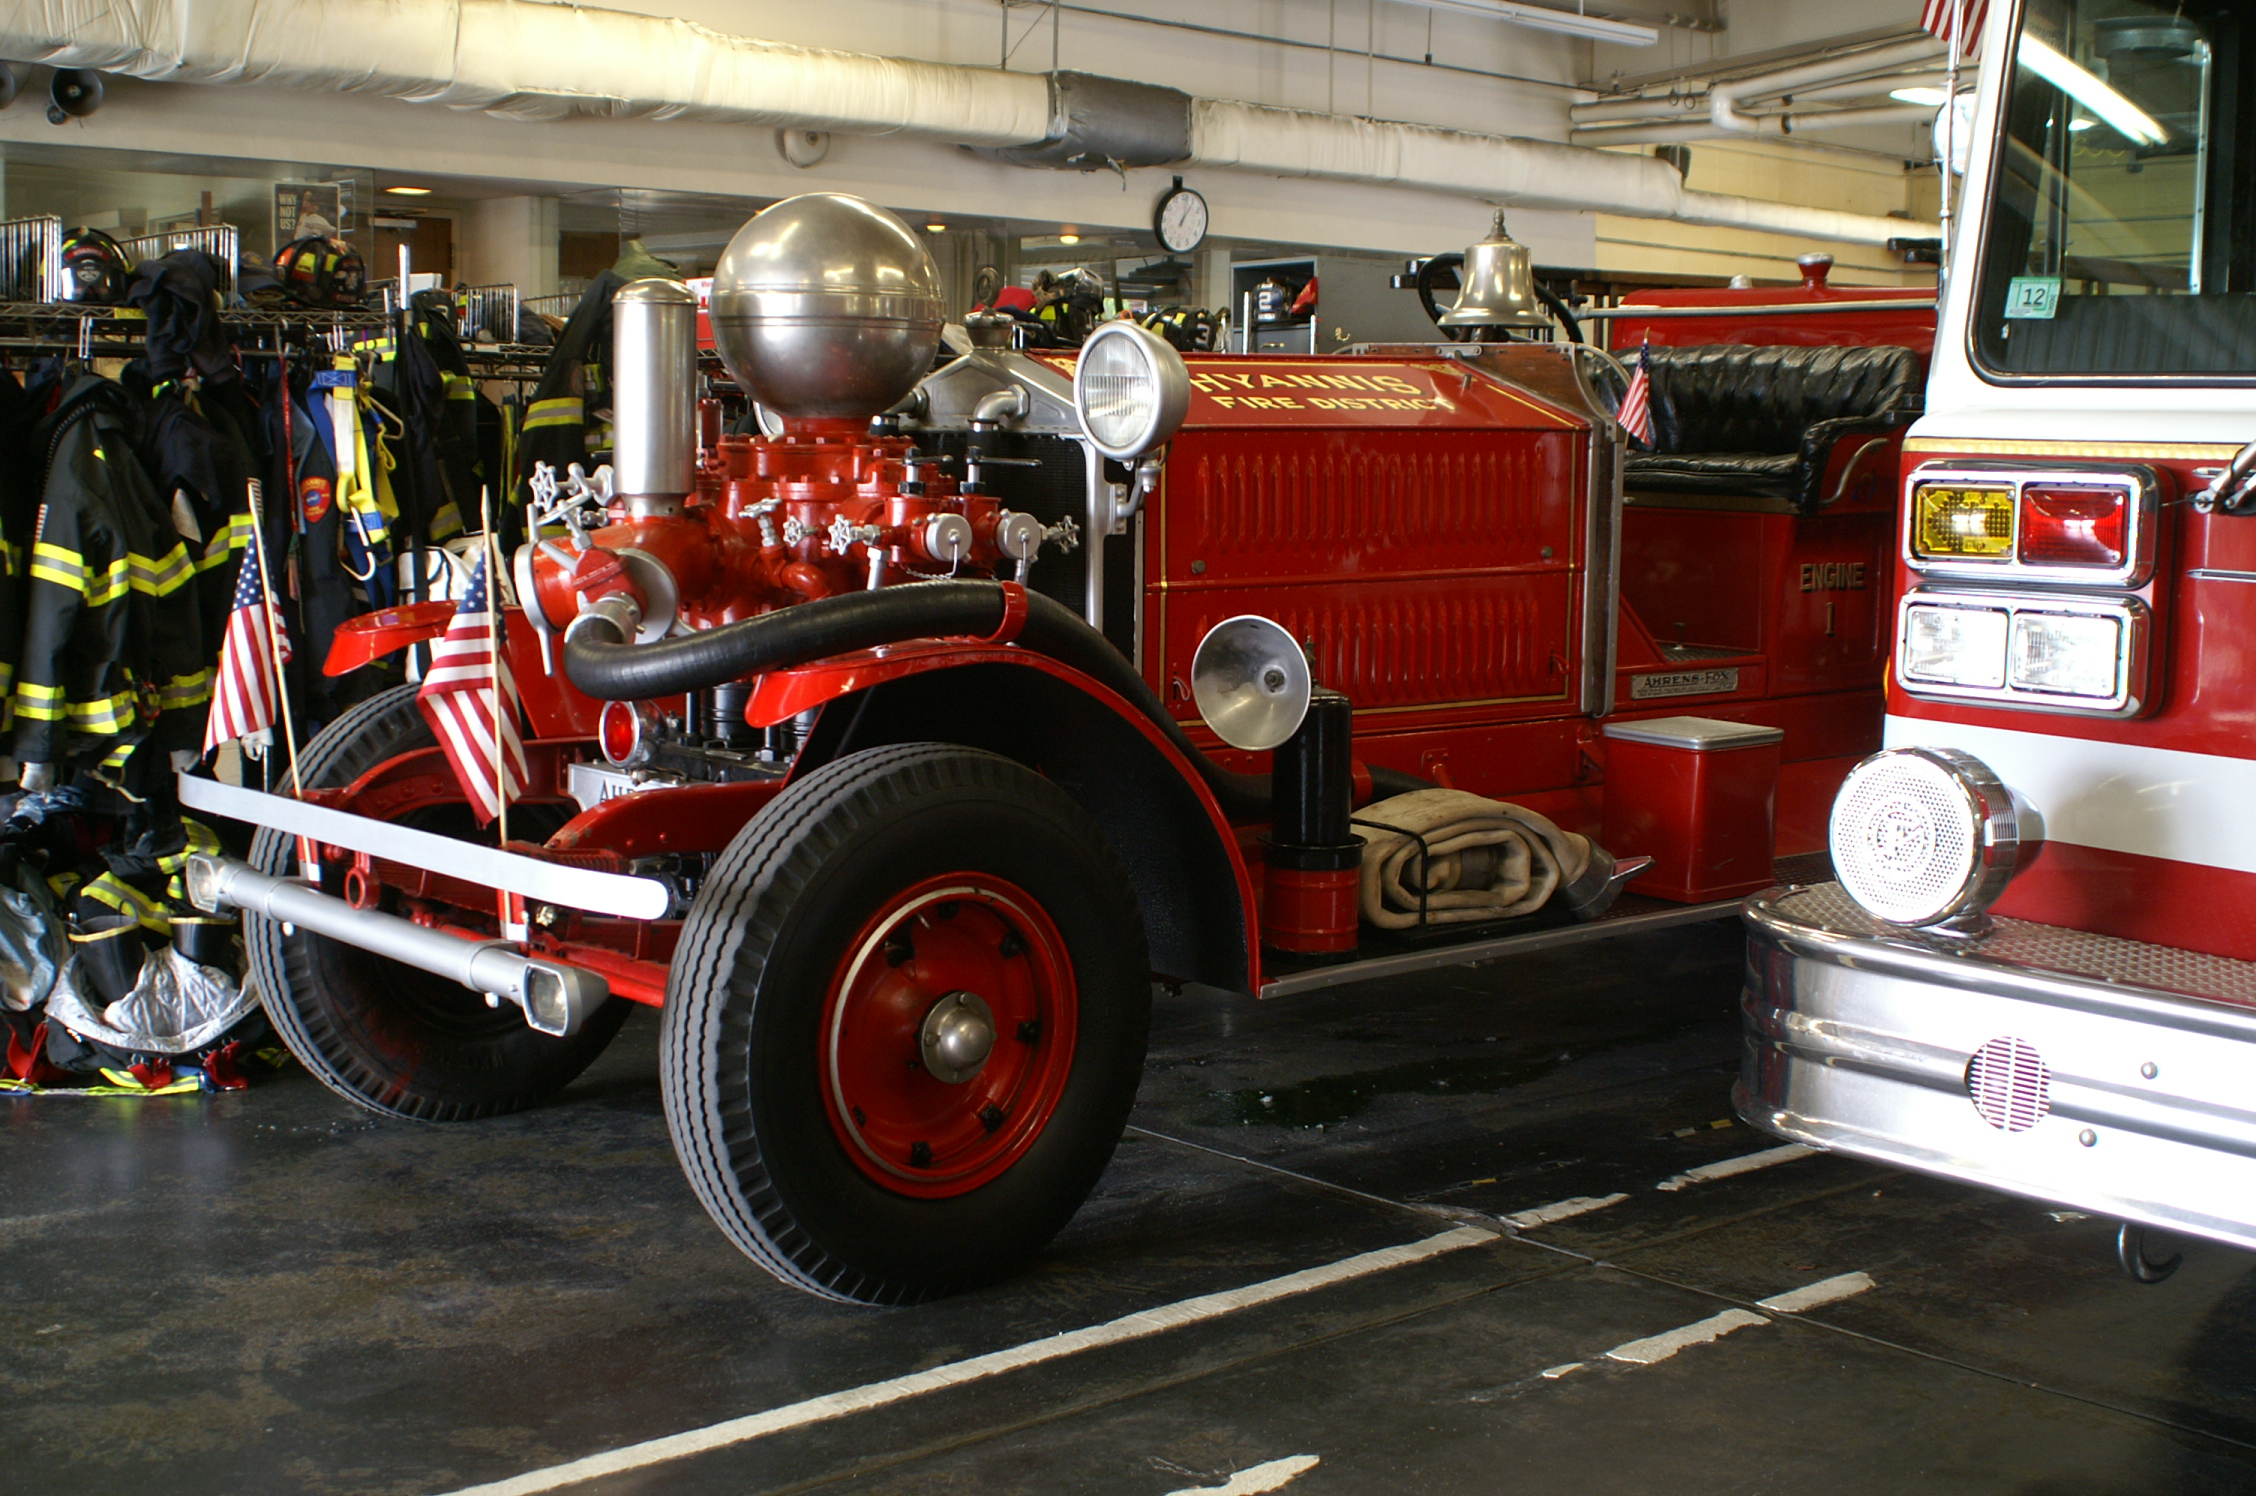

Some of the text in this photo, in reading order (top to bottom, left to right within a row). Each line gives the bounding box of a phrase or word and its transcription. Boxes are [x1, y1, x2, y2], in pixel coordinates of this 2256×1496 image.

[278, 193, 298, 205] WHY
[279, 205, 297, 217] NOT
[280, 217, 297, 230] US?
[1259, 291, 1272, 310] 2
[2022, 287, 2046, 306] 12
[1195, 323, 1210, 346] 3
[1189, 373, 1424, 395] HYANNIS
[1210, 396, 1456, 411] FIRE DISTRICT
[1800, 562, 1866, 592] ENGINE
[1825, 602, 1834, 635] 1
[1643, 671, 1730, 688] AHRENS-FOX
